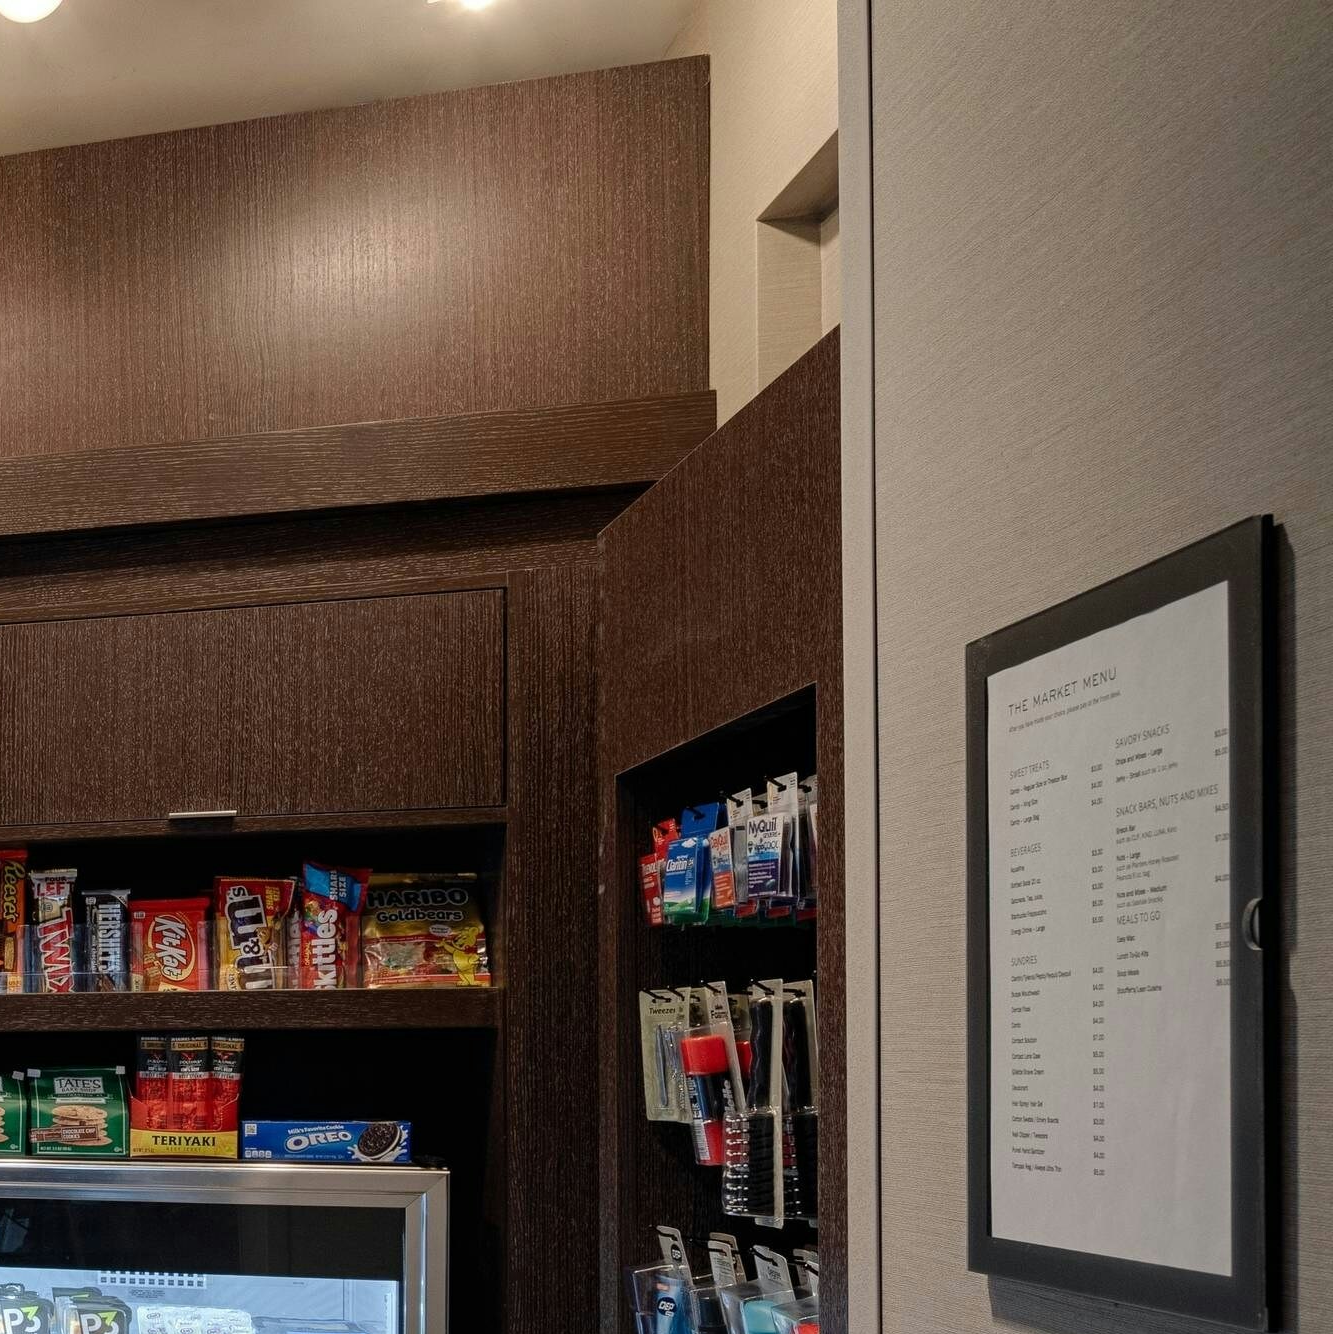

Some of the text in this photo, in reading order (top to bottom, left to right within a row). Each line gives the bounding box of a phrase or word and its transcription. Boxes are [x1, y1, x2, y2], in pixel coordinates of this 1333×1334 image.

[1009, 699, 1028, 717] THE
[1033, 681, 1077, 708] MARKET
[1083, 667, 1117, 690] MENU
[1115, 723, 1170, 749] SAVORY SNACKS
[1010, 760, 1050, 780] SWEET TREATS
[1116, 804, 1137, 818] SNACK
[1159, 793, 1179, 807] NUTS
[1180, 789, 1195, 802] AND
[748, 817, 778, 838] NyQuil
[710, 832, 730, 851] DayQuil
[666, 858, 688, 872] Claritin
[4, 859, 26, 924] Reese's
[367, 888, 469, 908] HARIBO
[376, 908, 464, 924] Goldbears
[1150, 910, 1161, 921] GO
[37, 907, 75, 993] TWIX
[56, 1077, 101, 1090] TATE'S
[152, 1135, 216, 1146] TERIYAKI
[285, 1131, 352, 1152] OREO
[3, 1306, 42, 1334] P3
